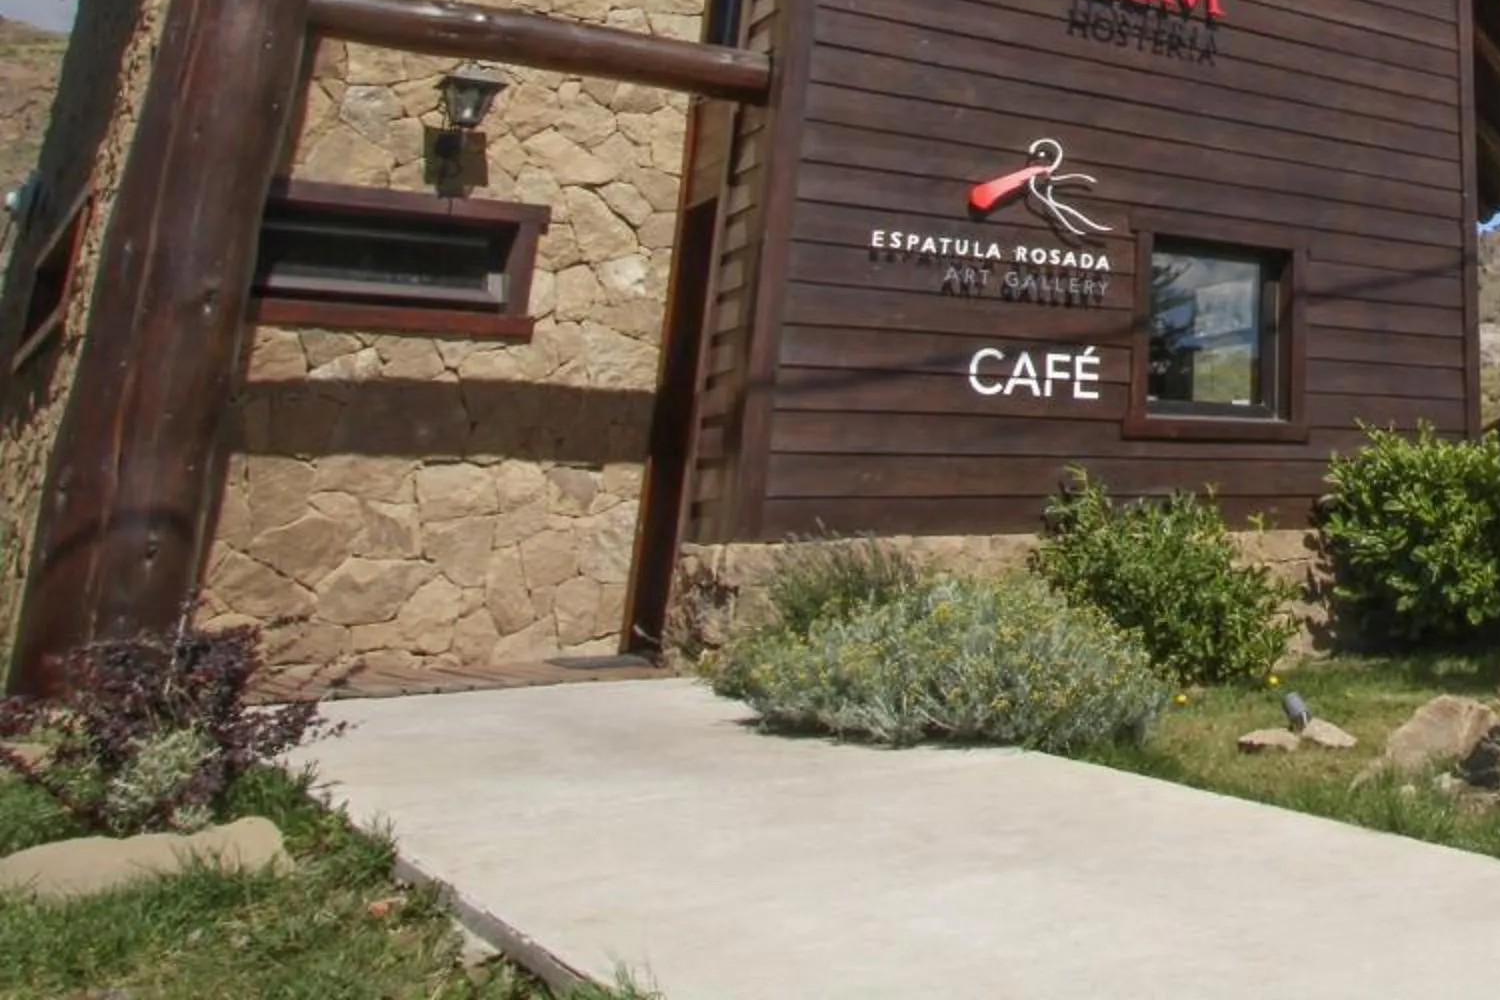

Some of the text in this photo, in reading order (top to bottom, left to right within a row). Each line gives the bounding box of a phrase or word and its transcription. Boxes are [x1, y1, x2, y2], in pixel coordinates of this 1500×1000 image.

[870, 230, 1112, 272] ESPATULA ROSADA
[943, 265, 1110, 297] ART GALLERY
[968, 345, 1101, 400] CAFÉ
